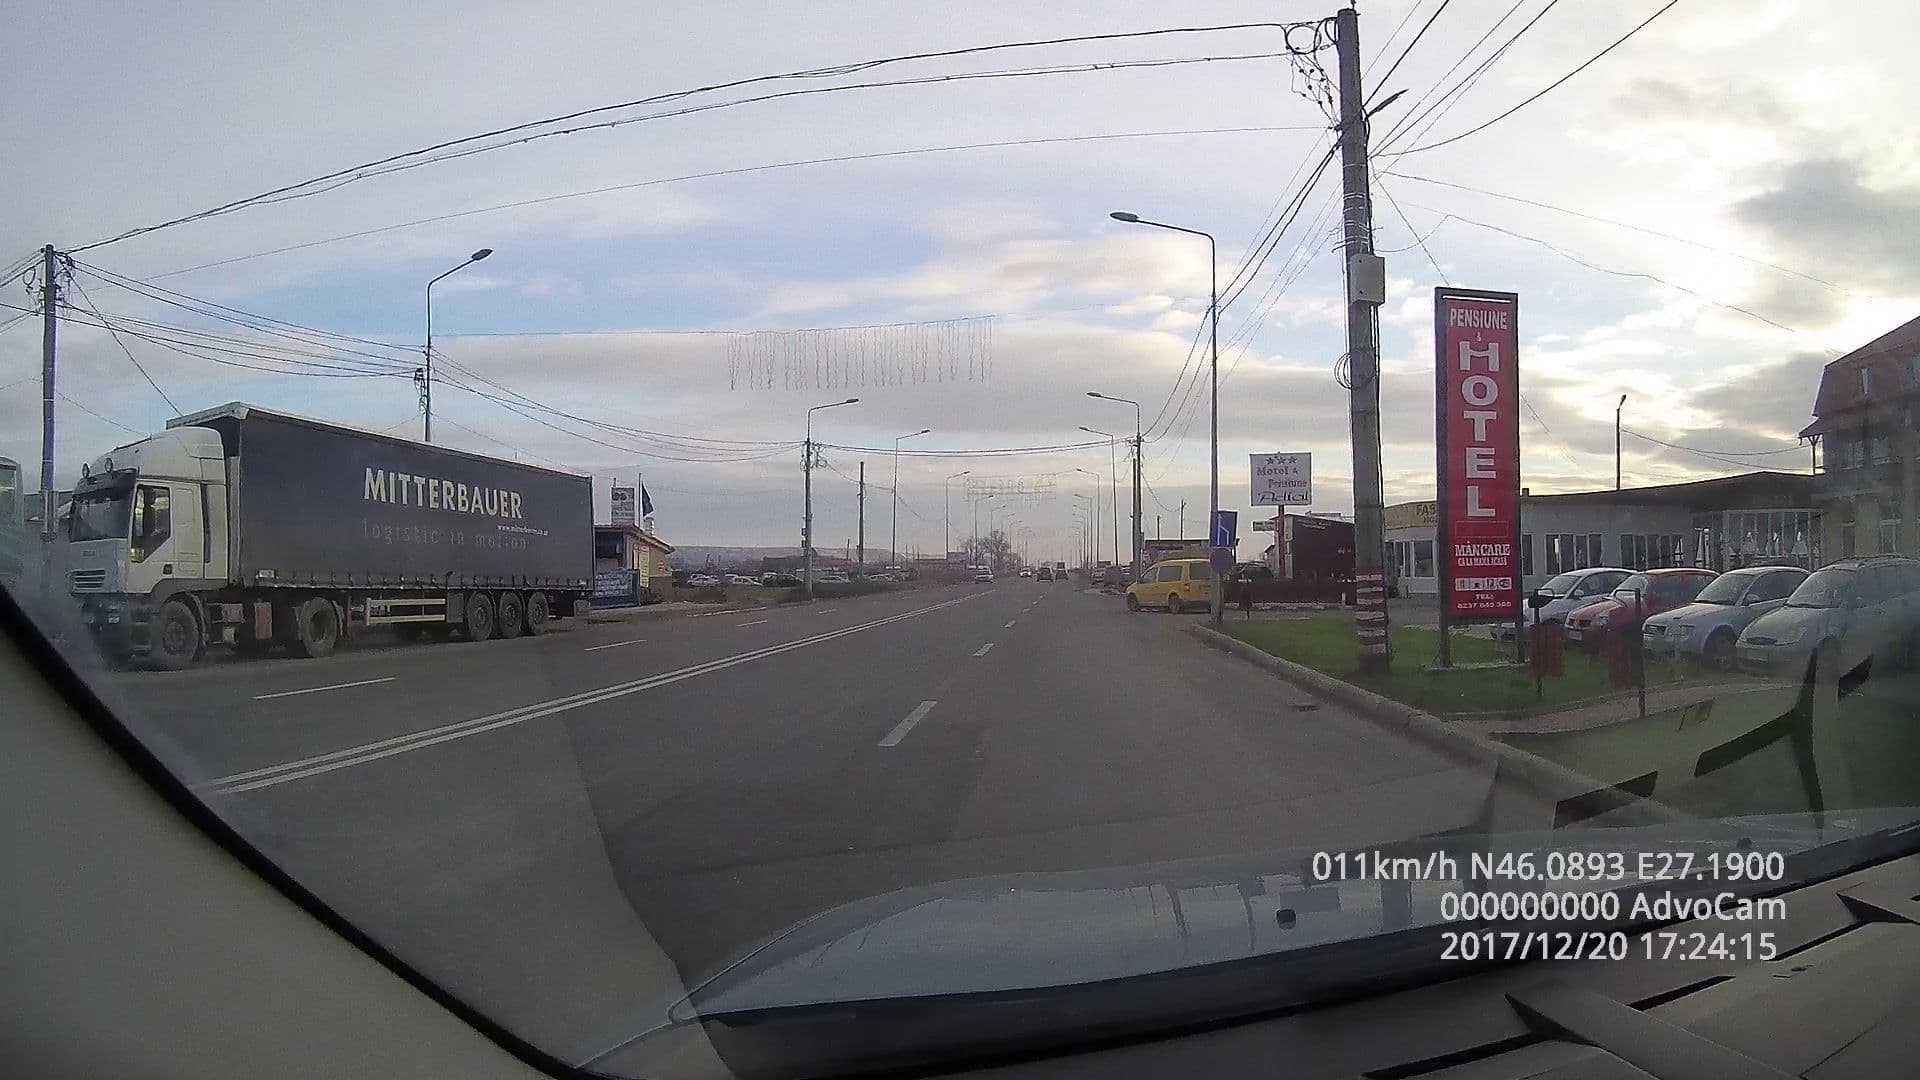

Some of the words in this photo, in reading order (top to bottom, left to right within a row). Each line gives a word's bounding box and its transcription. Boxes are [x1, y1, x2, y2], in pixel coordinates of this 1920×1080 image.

[1449, 308, 1508, 330] PENSIUNE
[1458, 340, 1500, 518] HOTEL
[363, 466, 523, 519] MITTERBAUER
[362, 518, 440, 546] logistic
[450, 529, 465, 545] in
